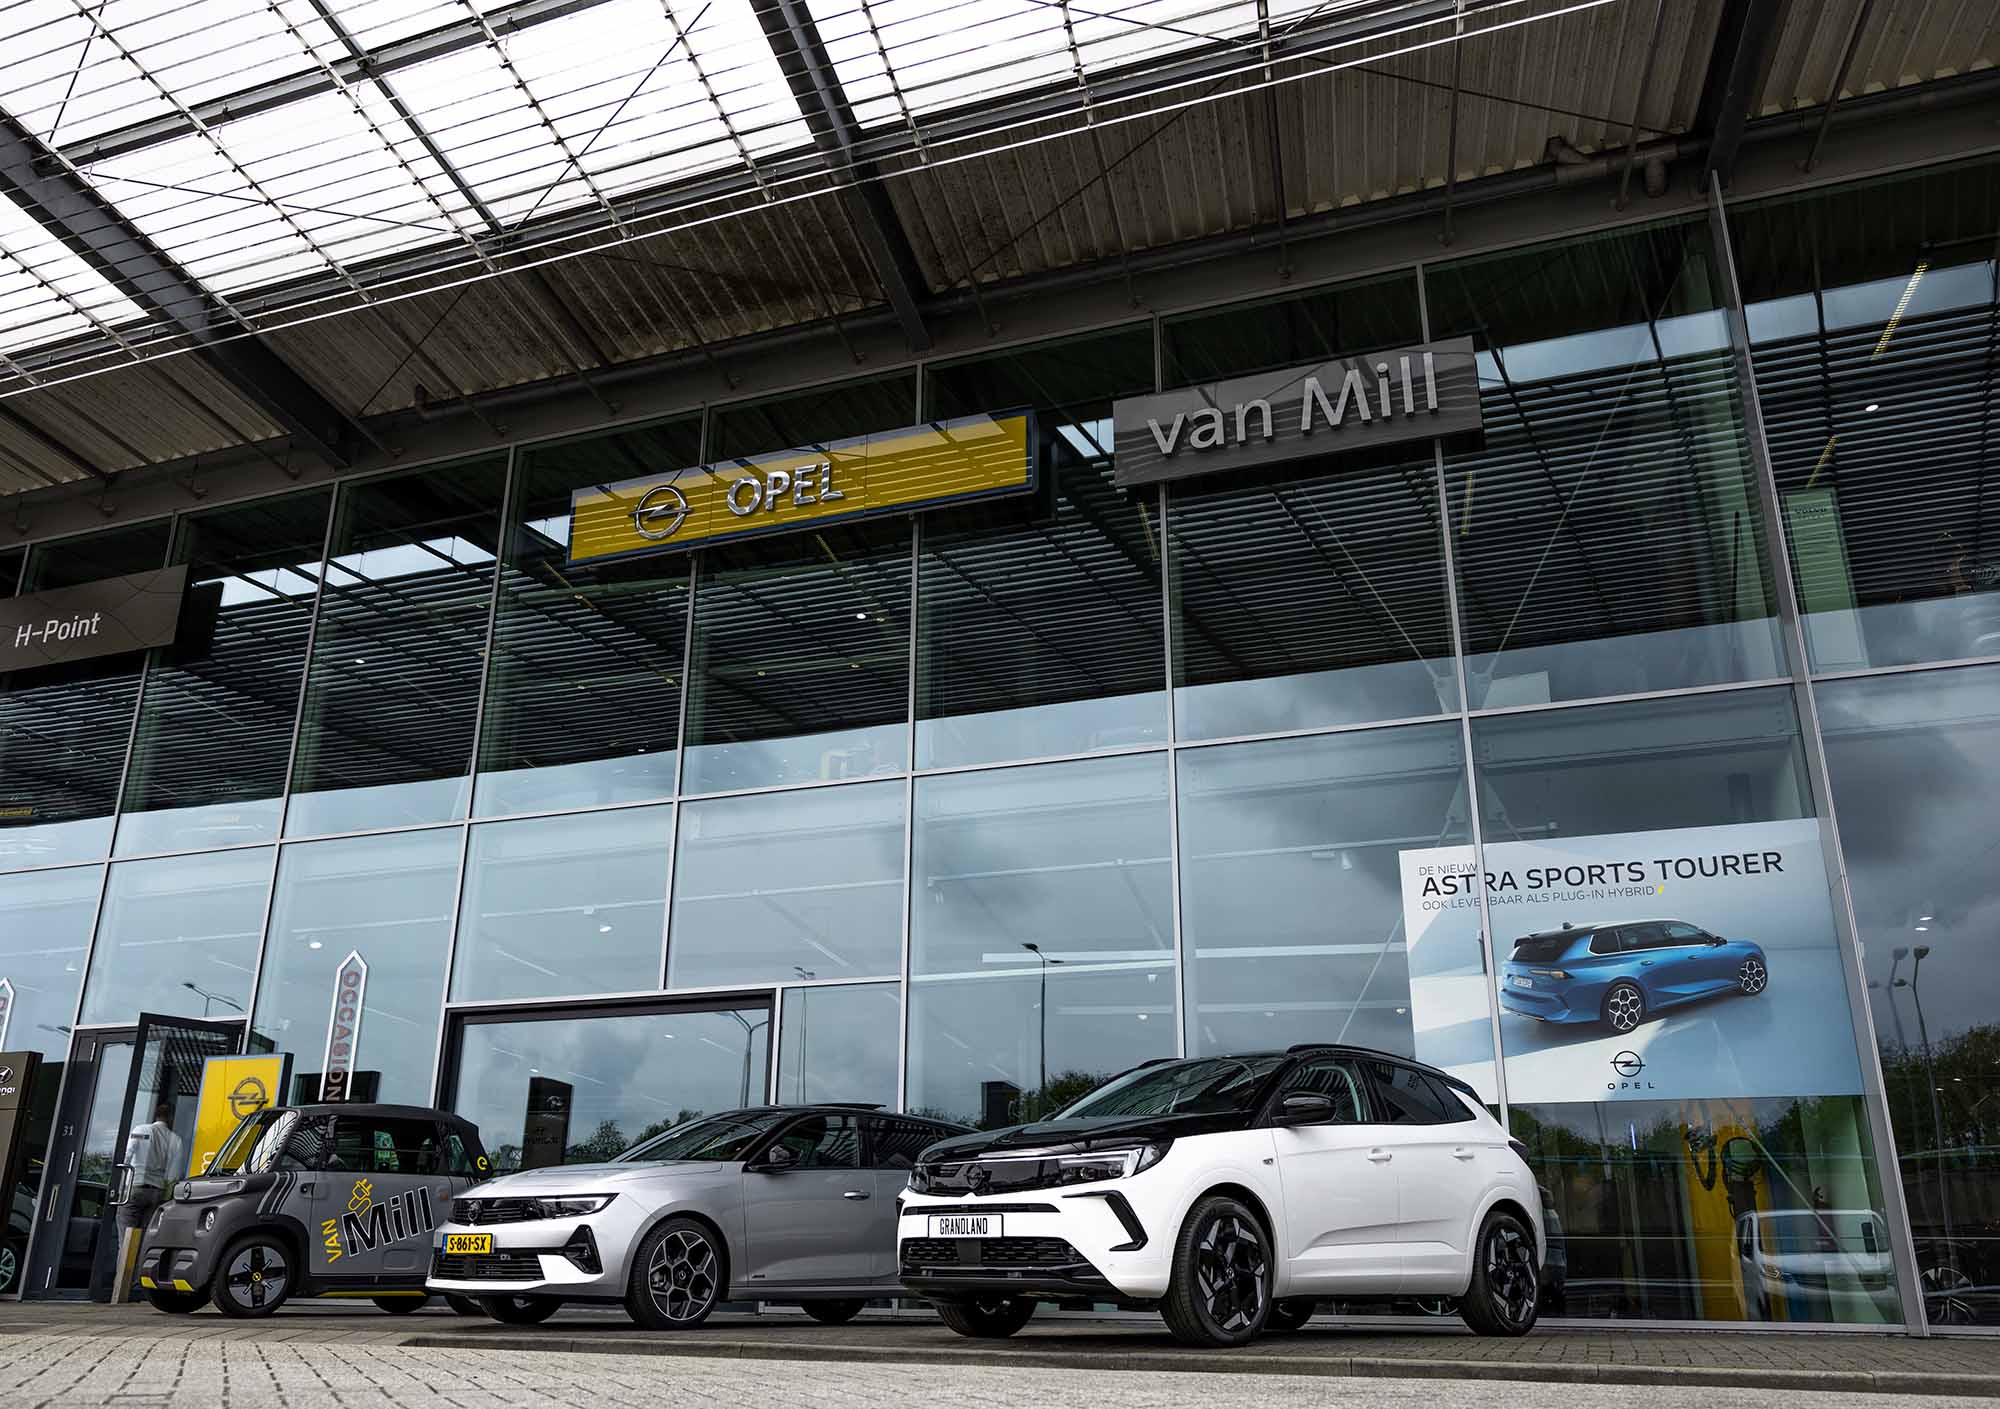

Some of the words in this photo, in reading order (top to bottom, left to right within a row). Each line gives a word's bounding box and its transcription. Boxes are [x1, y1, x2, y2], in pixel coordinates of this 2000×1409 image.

[1148, 398, 1273, 455] van
[1301, 352, 1438, 433] Mill
[727, 463, 844, 516] OPEL
[14, 612, 101, 648] H-Point
[1418, 866, 1434, 876] DE
[1438, 863, 1478, 875] NIEUW
[1422, 871, 1518, 897] ASTRA
[1526, 861, 1646, 889] SPORTS
[1653, 851, 1784, 881] TOURER
[1422, 900, 1449, 911] OOK
[1451, 894, 1523, 909] LEVEBAAR
[1526, 892, 1549, 904] ALS
[1552, 889, 1605, 902] PLUG-IN
[1608, 886, 1655, 898] HYBRID
[1607, 1081, 1655, 1090] OPEL
[321, 1219, 342, 1264] VAN
[341, 1186, 434, 1257] Mill
[939, 1217, 988, 1235] GRANDLAND
